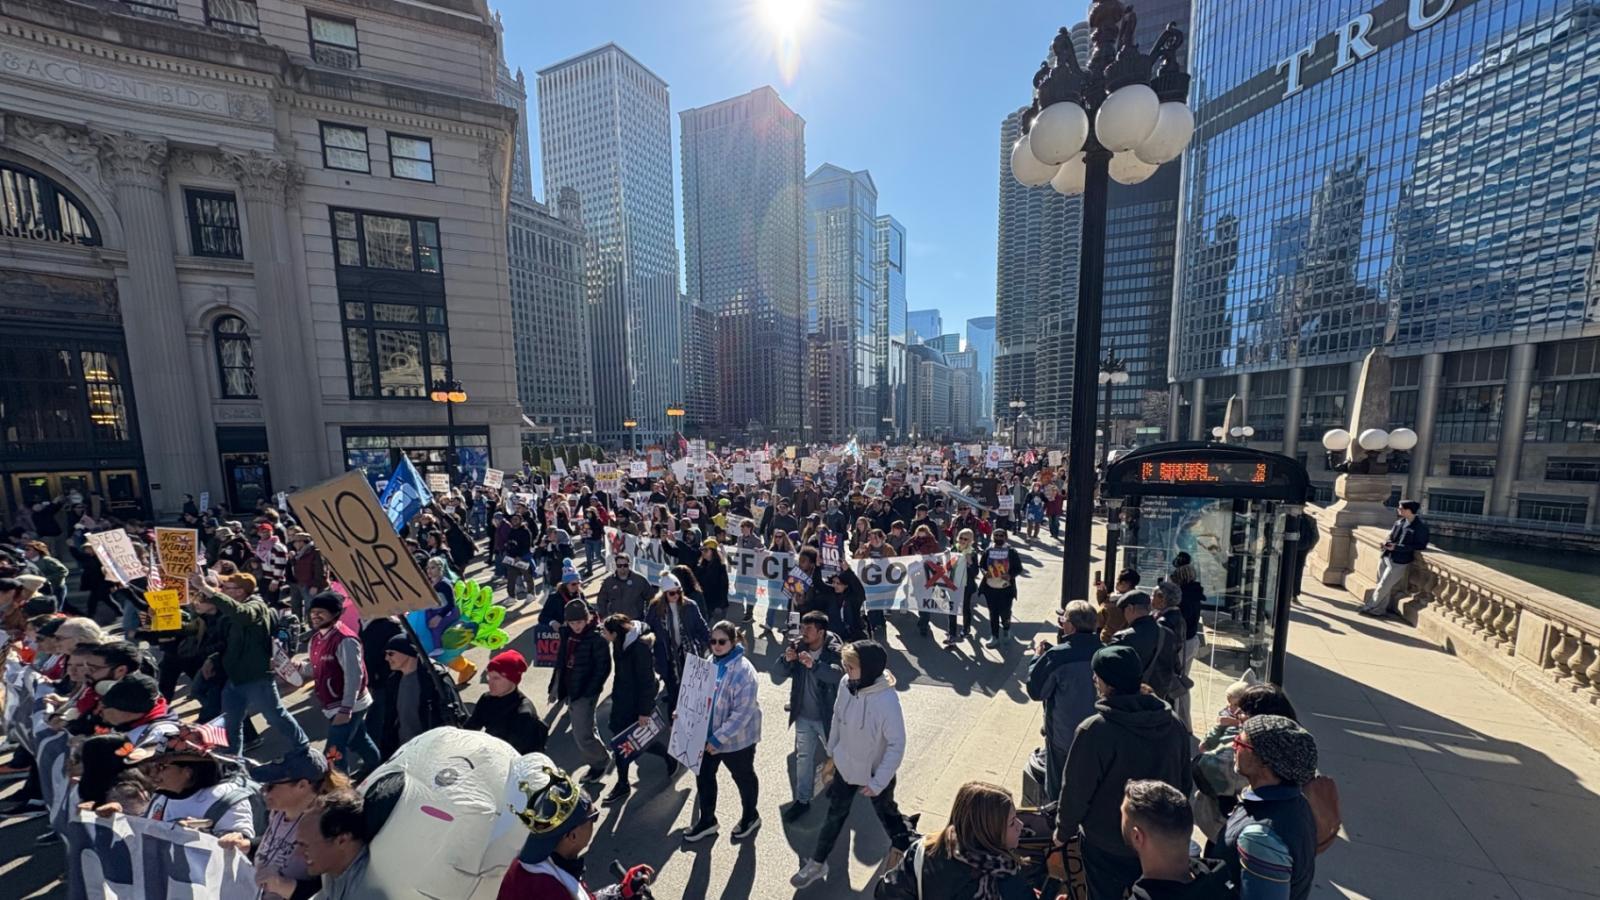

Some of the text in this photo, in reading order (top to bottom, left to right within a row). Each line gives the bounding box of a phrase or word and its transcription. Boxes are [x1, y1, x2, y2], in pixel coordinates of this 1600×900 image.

[26, 59, 151, 99] ACCIDENT
[304, 490, 379, 551] NO
[822, 547, 840, 560] NO
[167, 562, 192, 574] 1776
[323, 543, 422, 608] WAR
[537, 639, 561, 653] NO
